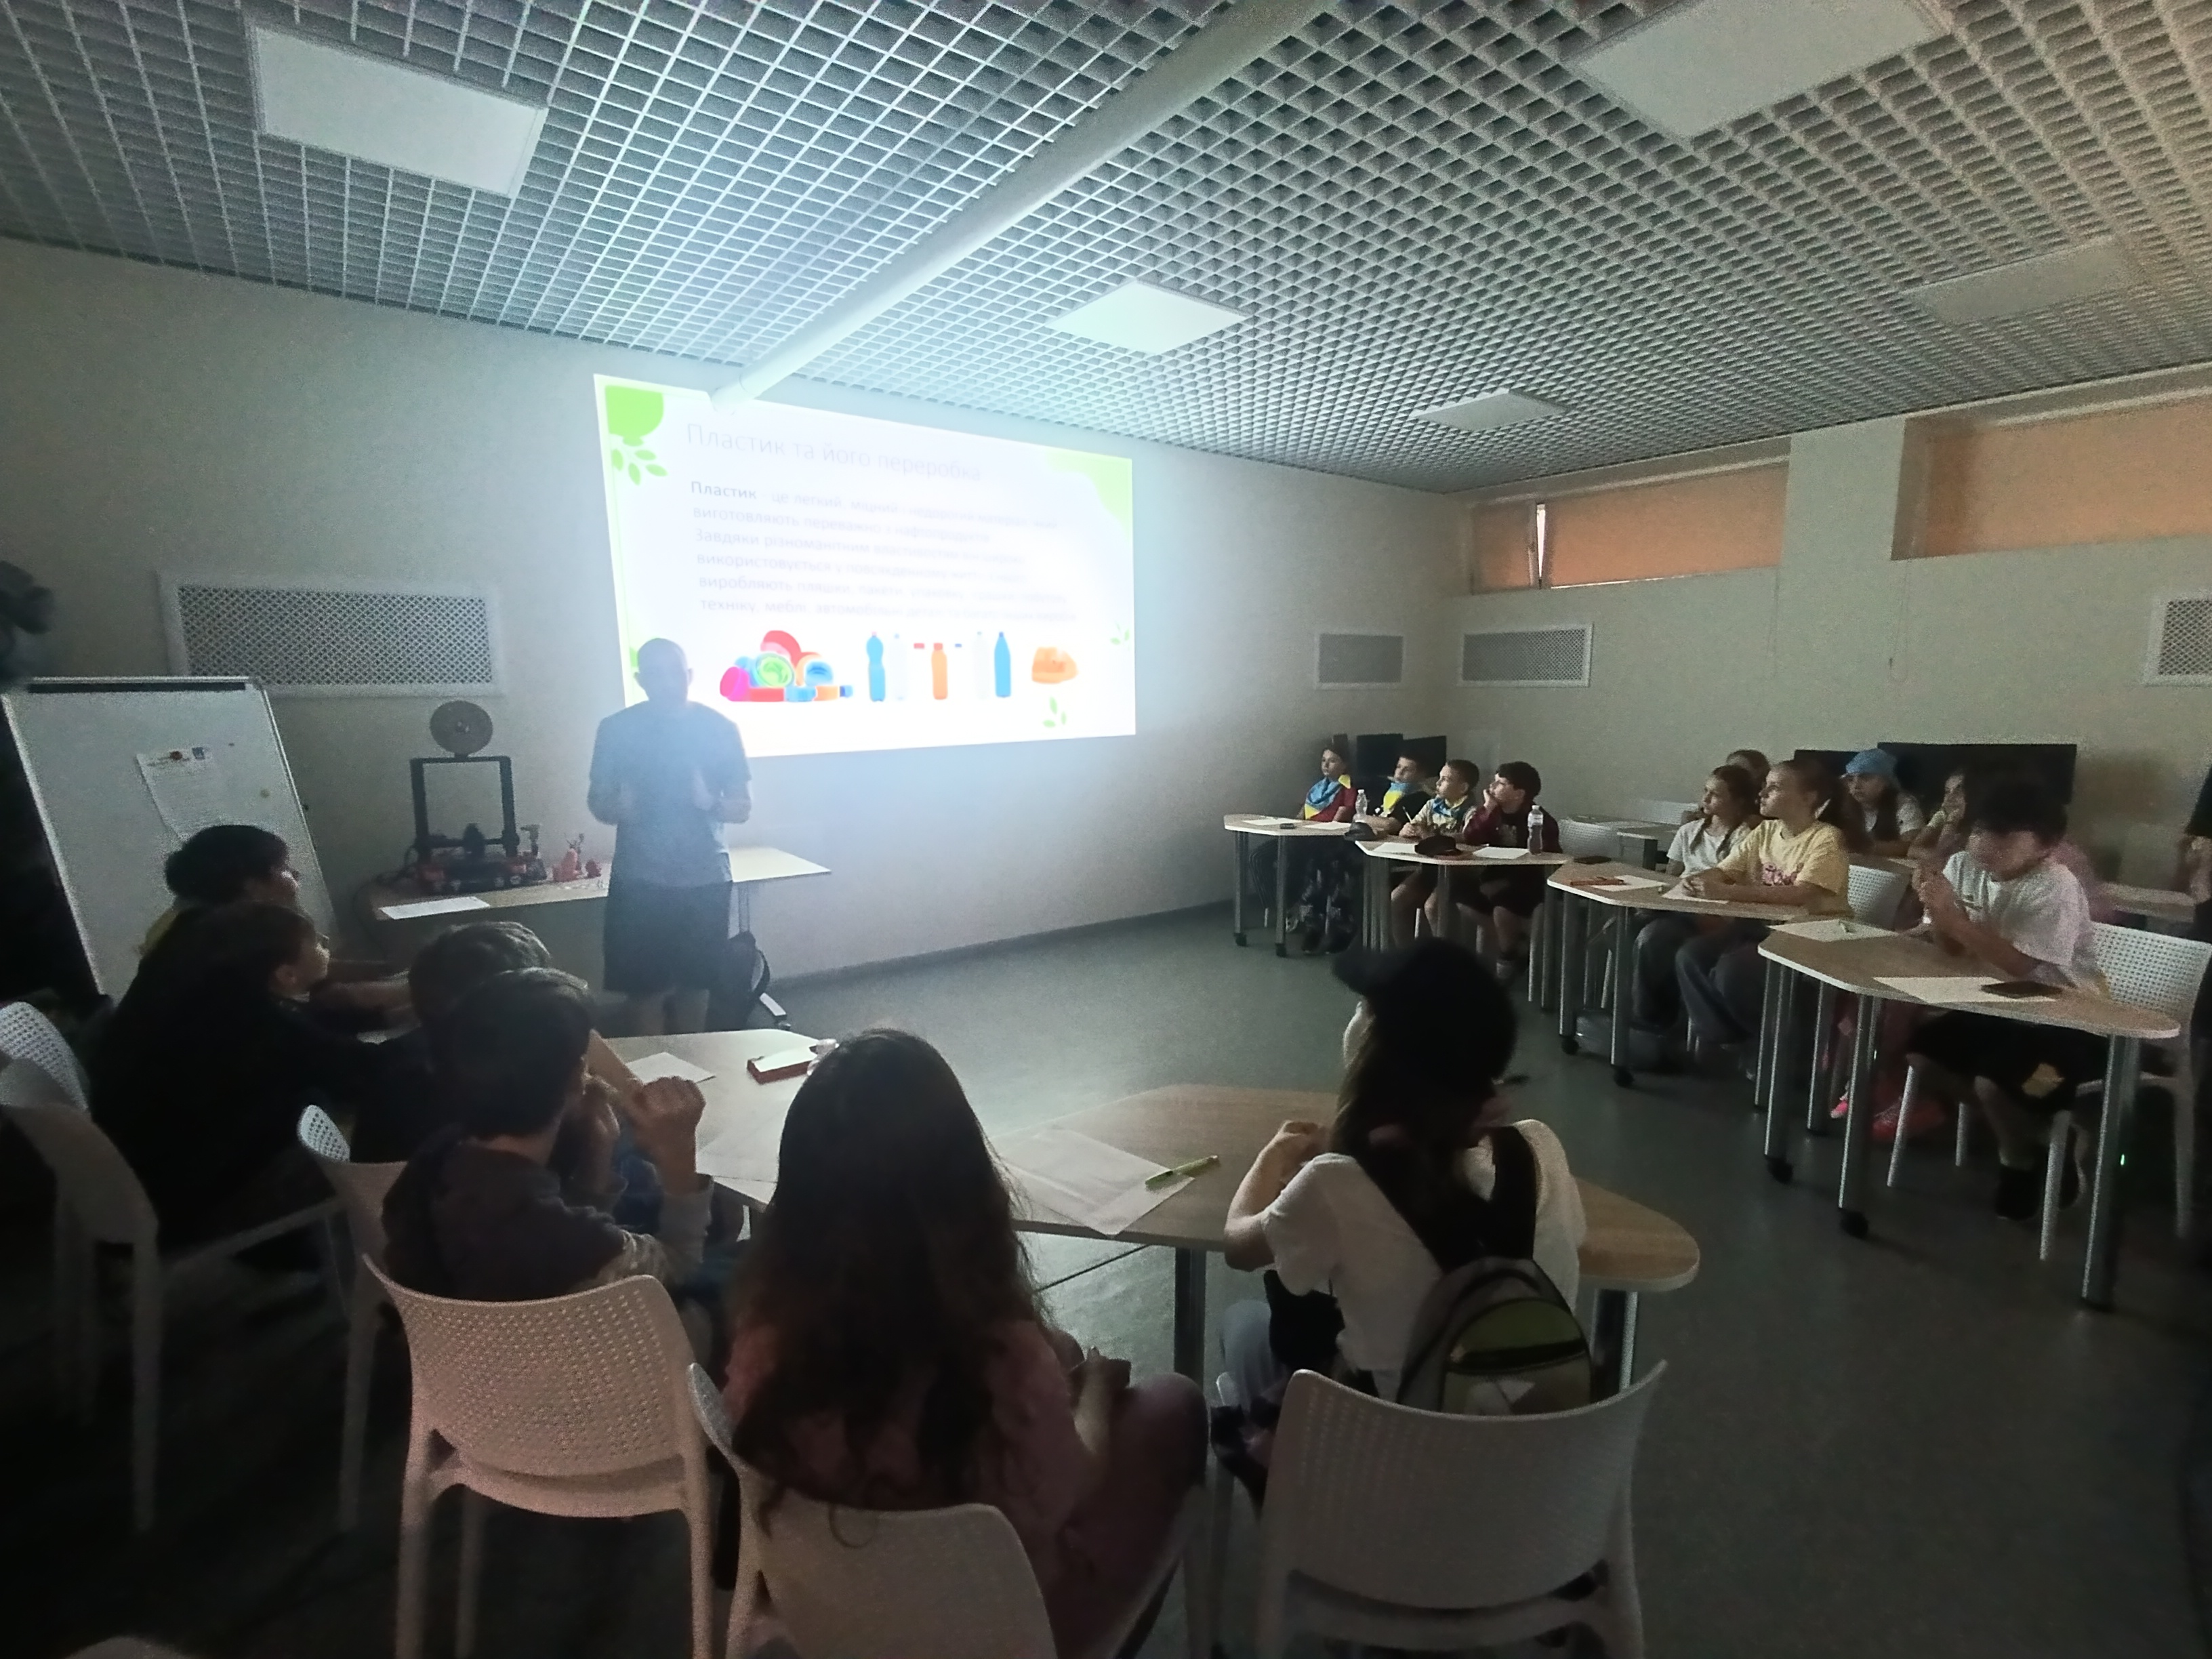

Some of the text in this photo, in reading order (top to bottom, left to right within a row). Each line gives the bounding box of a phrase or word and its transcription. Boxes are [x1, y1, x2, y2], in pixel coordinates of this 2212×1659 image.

[687, 423, 981, 482] Пластик та його переробка
[691, 480, 757, 499] Пластик
[771, 493, 790, 505] це
[693, 508, 800, 527] виготовляють
[804, 517, 882, 533] переважно
[695, 527, 760, 545] Завдяки
[764, 535, 870, 552] різноманітним
[697, 553, 832, 573] використовується
[699, 575, 794, 592] виробляють
